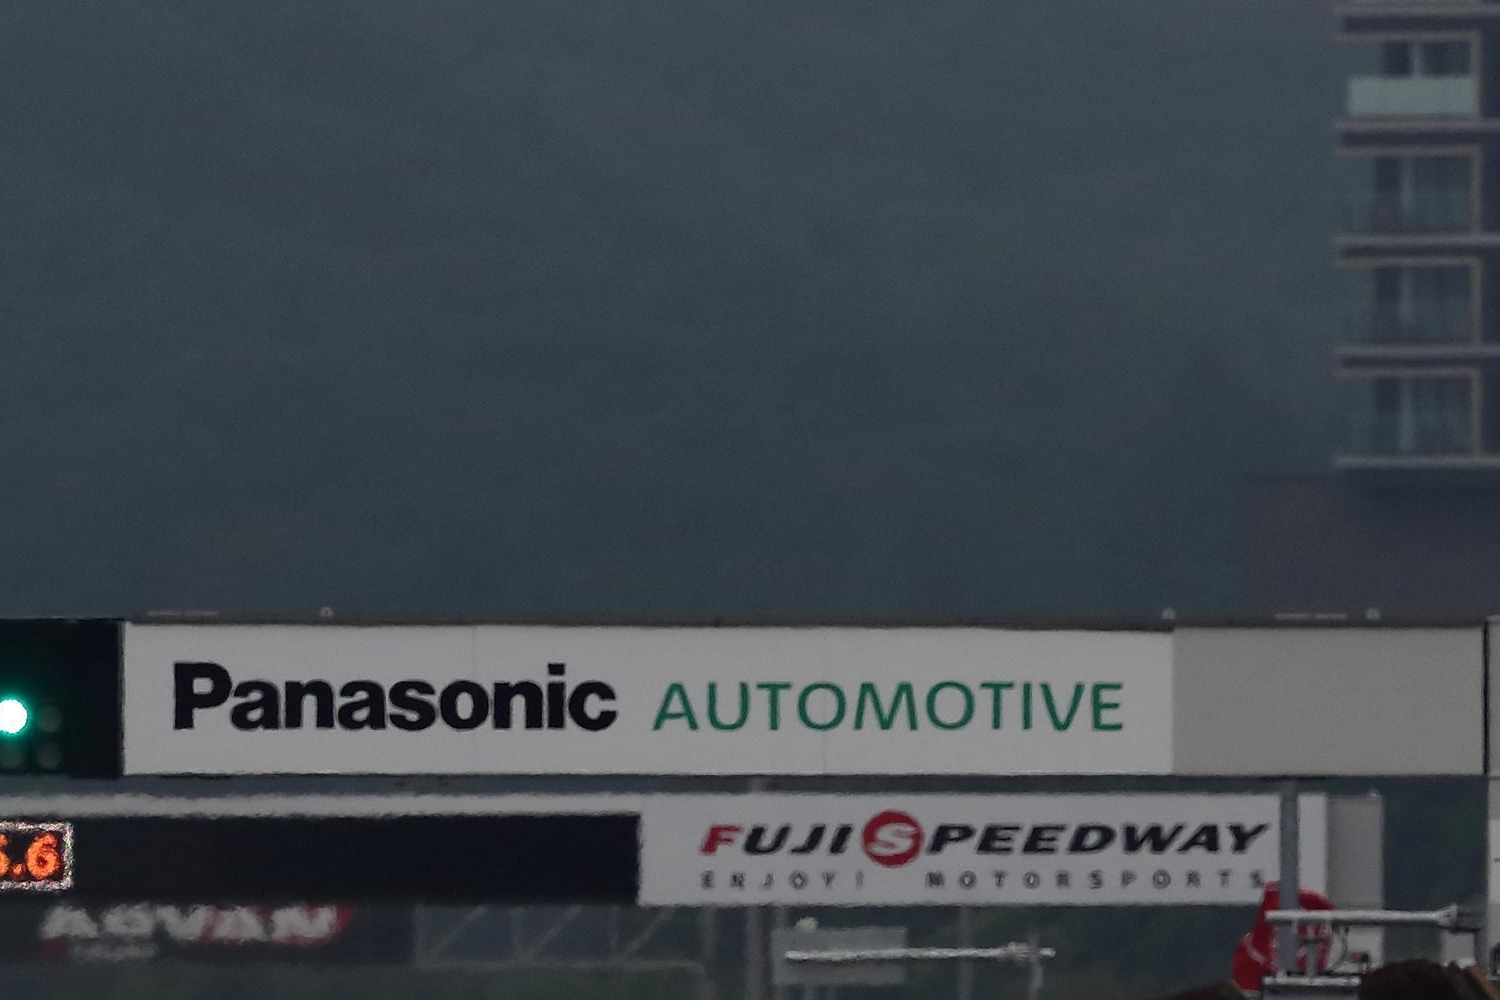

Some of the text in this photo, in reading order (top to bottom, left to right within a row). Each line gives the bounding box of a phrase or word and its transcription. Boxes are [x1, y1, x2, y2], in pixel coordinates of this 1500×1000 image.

[173, 660, 1124, 731] Panasonic AUTOMOTIVE
[699, 813, 1269, 864] FUJI SPEEDWAY
[924, 868, 1266, 891] MOTORSPORTS
[40, 904, 338, 941] ADVAN
